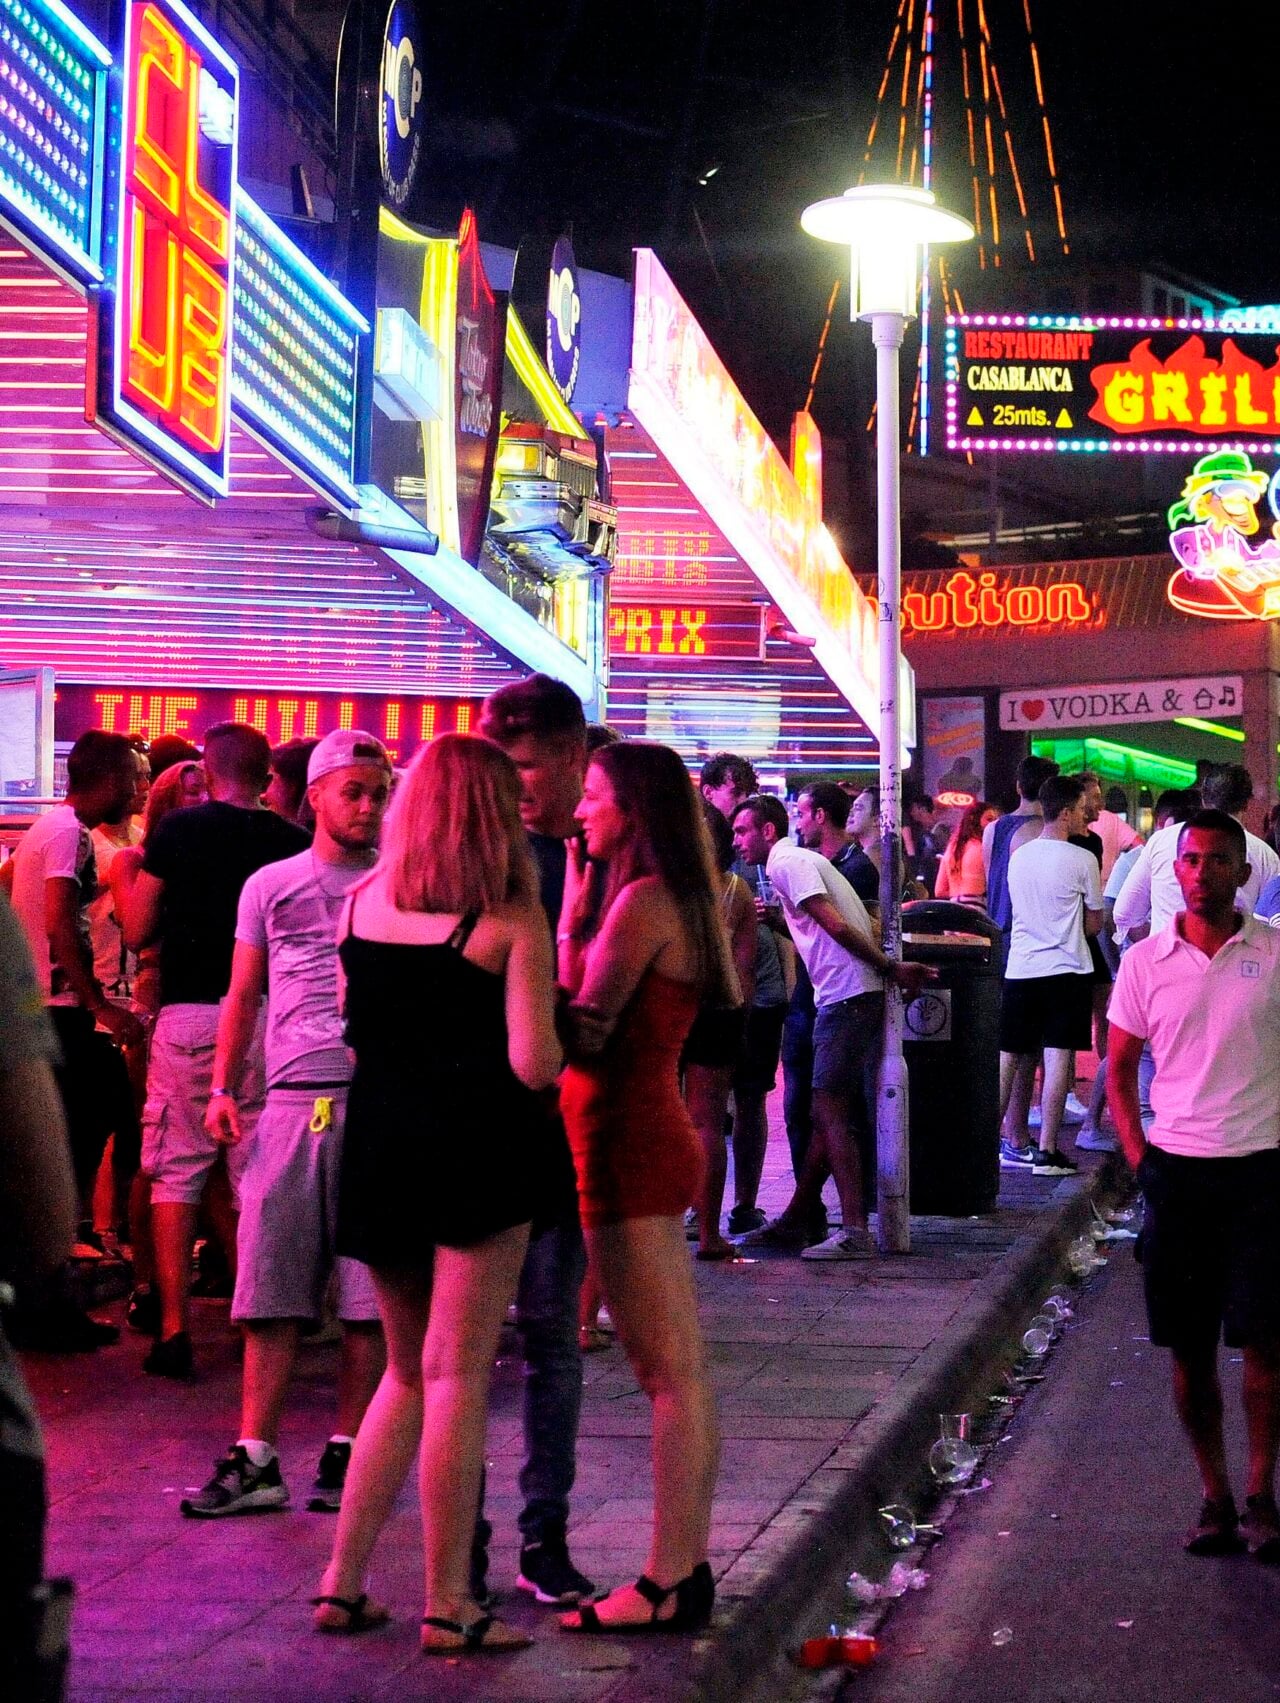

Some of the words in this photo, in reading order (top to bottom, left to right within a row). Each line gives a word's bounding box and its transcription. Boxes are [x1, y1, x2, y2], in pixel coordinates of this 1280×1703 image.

[964, 331, 1093, 360] RESTAURANT
[967, 365, 1073, 392] CASABLANCA
[992, 404, 1052, 426] 25mts.
[899, 572, 1090, 630] ution
[1008, 701, 1017, 722] I
[1047, 692, 1153, 720] VODKA
[1162, 689, 1183, 711] &
